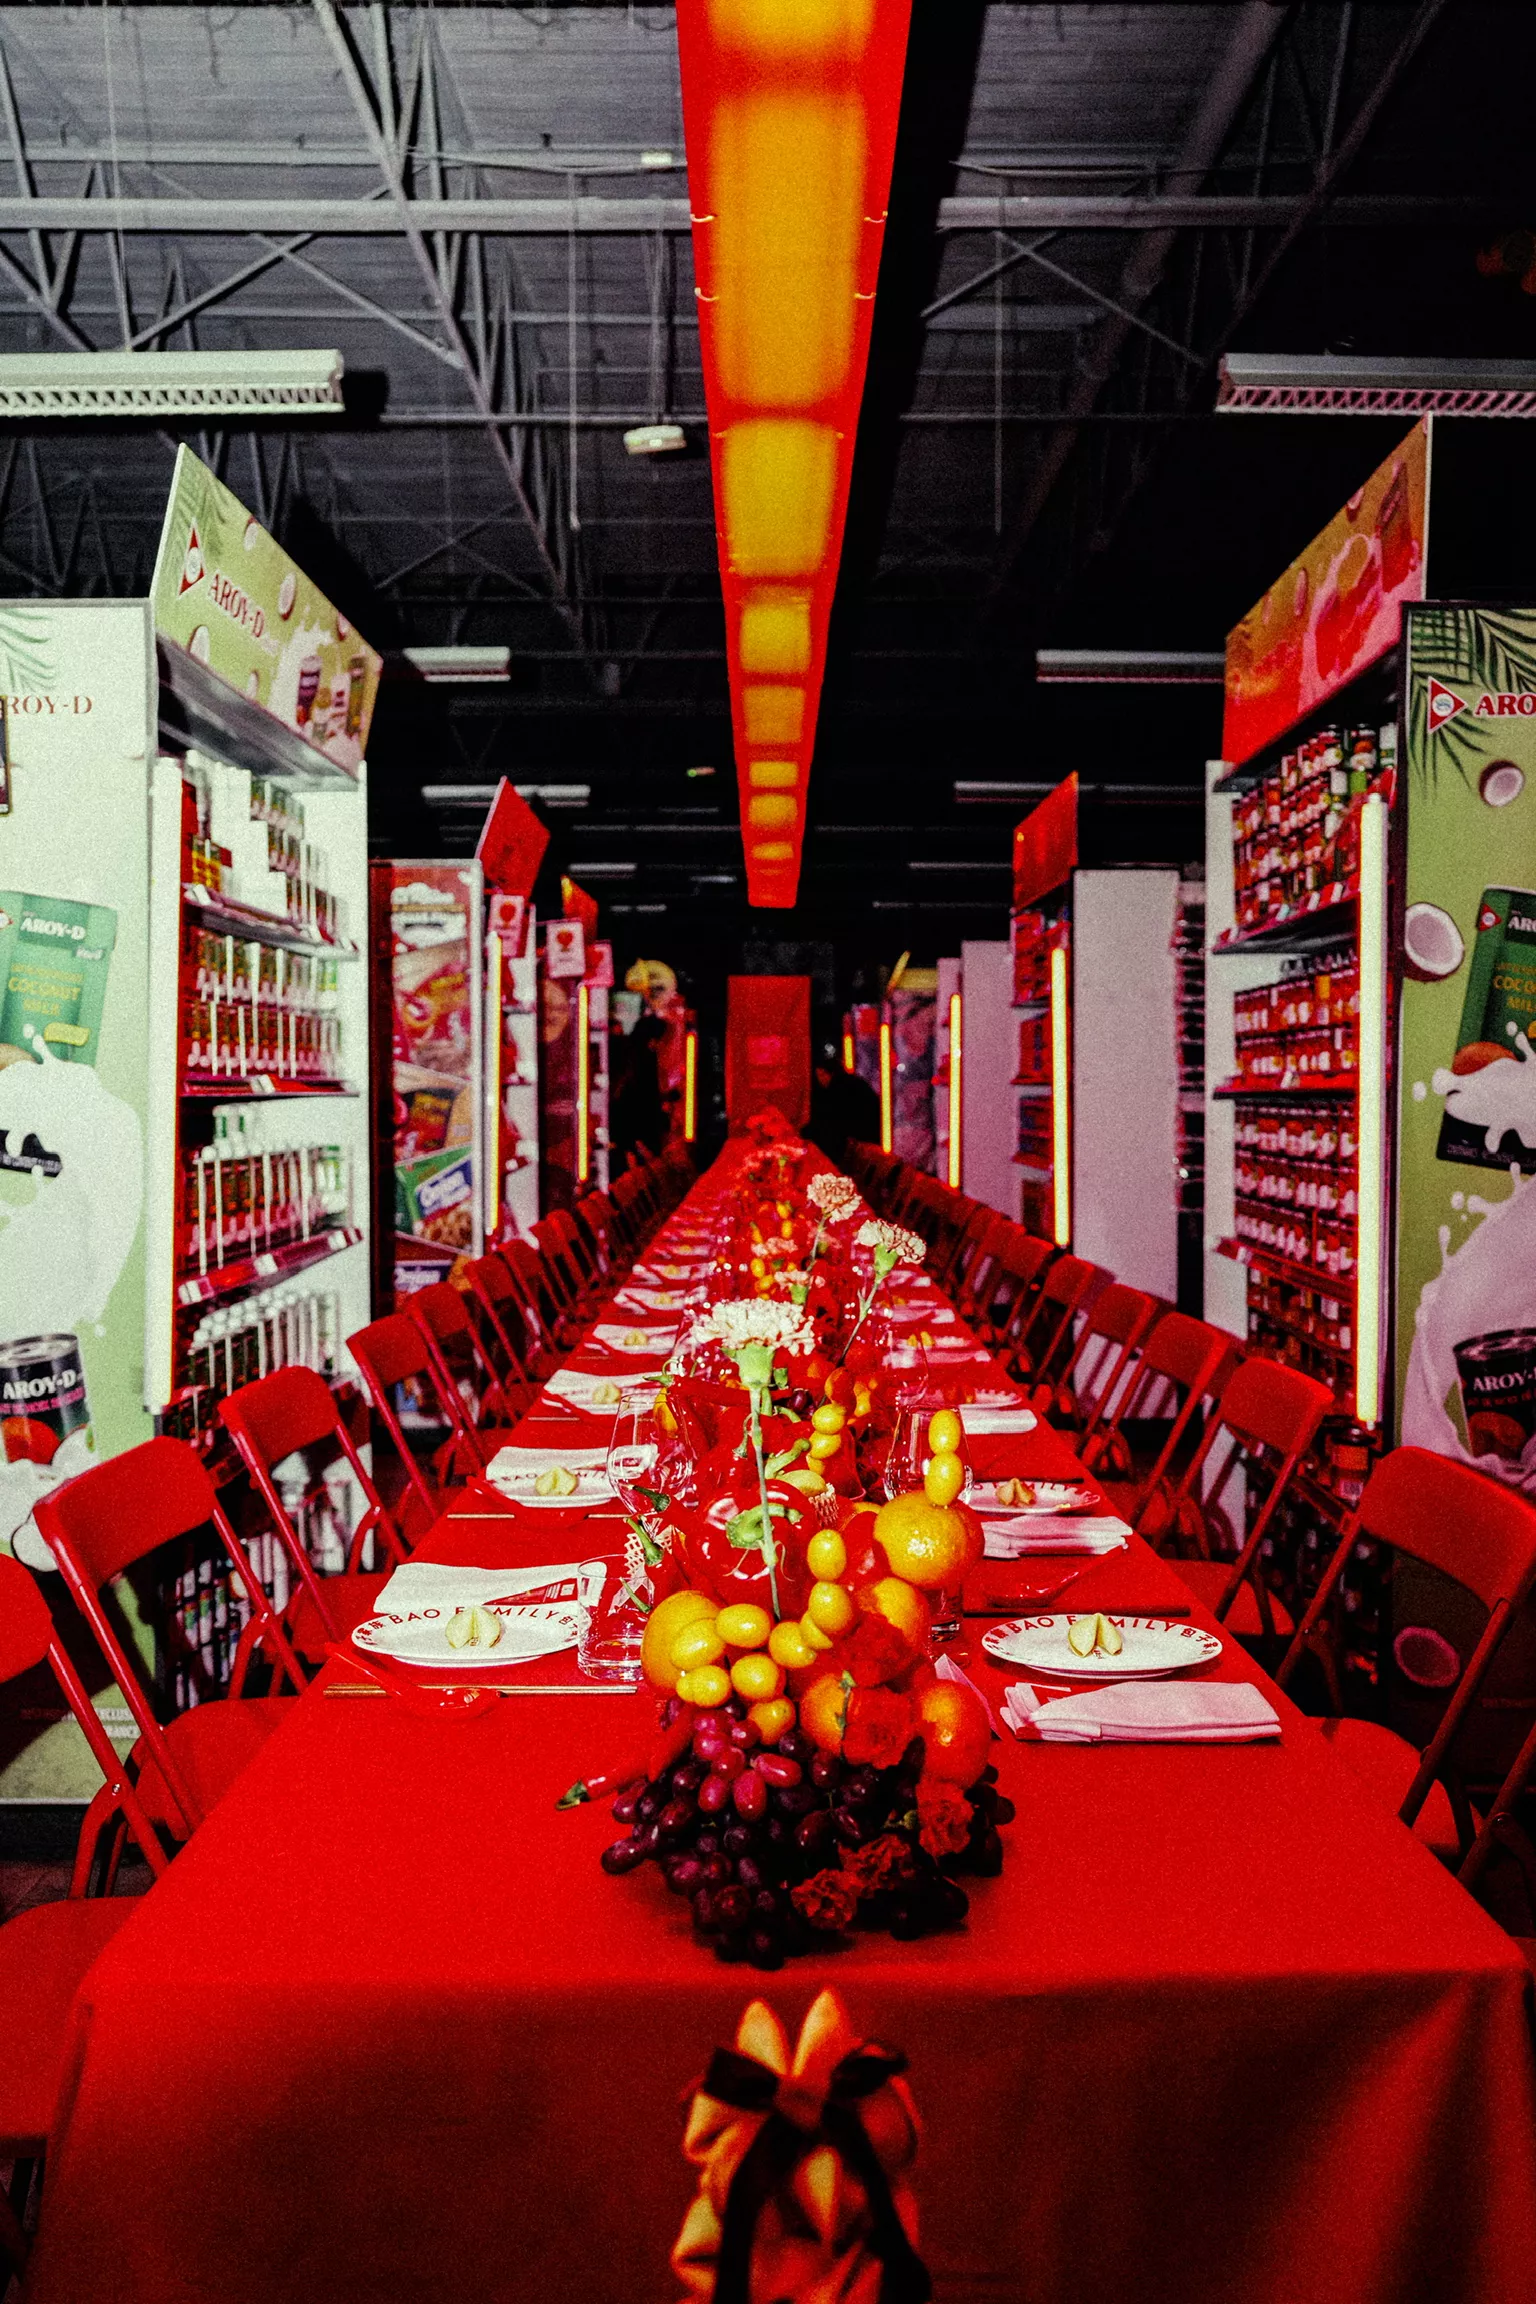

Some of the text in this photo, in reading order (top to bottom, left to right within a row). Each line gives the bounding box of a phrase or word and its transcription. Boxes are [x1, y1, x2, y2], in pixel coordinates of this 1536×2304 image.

[207, 573, 265, 638] AROY-D
[1474, 692, 1536, 716] ARO
[20, 917, 86, 941] AROY-D
[1493, 974, 1536, 995] COCO
[1507, 995, 1536, 1013] MIL
[3, 1368, 77, 1400] AROY-D
[388, 1606, 560, 1624] BAO FMILY
[1005, 1615, 1177, 1634] BAO FMILY
